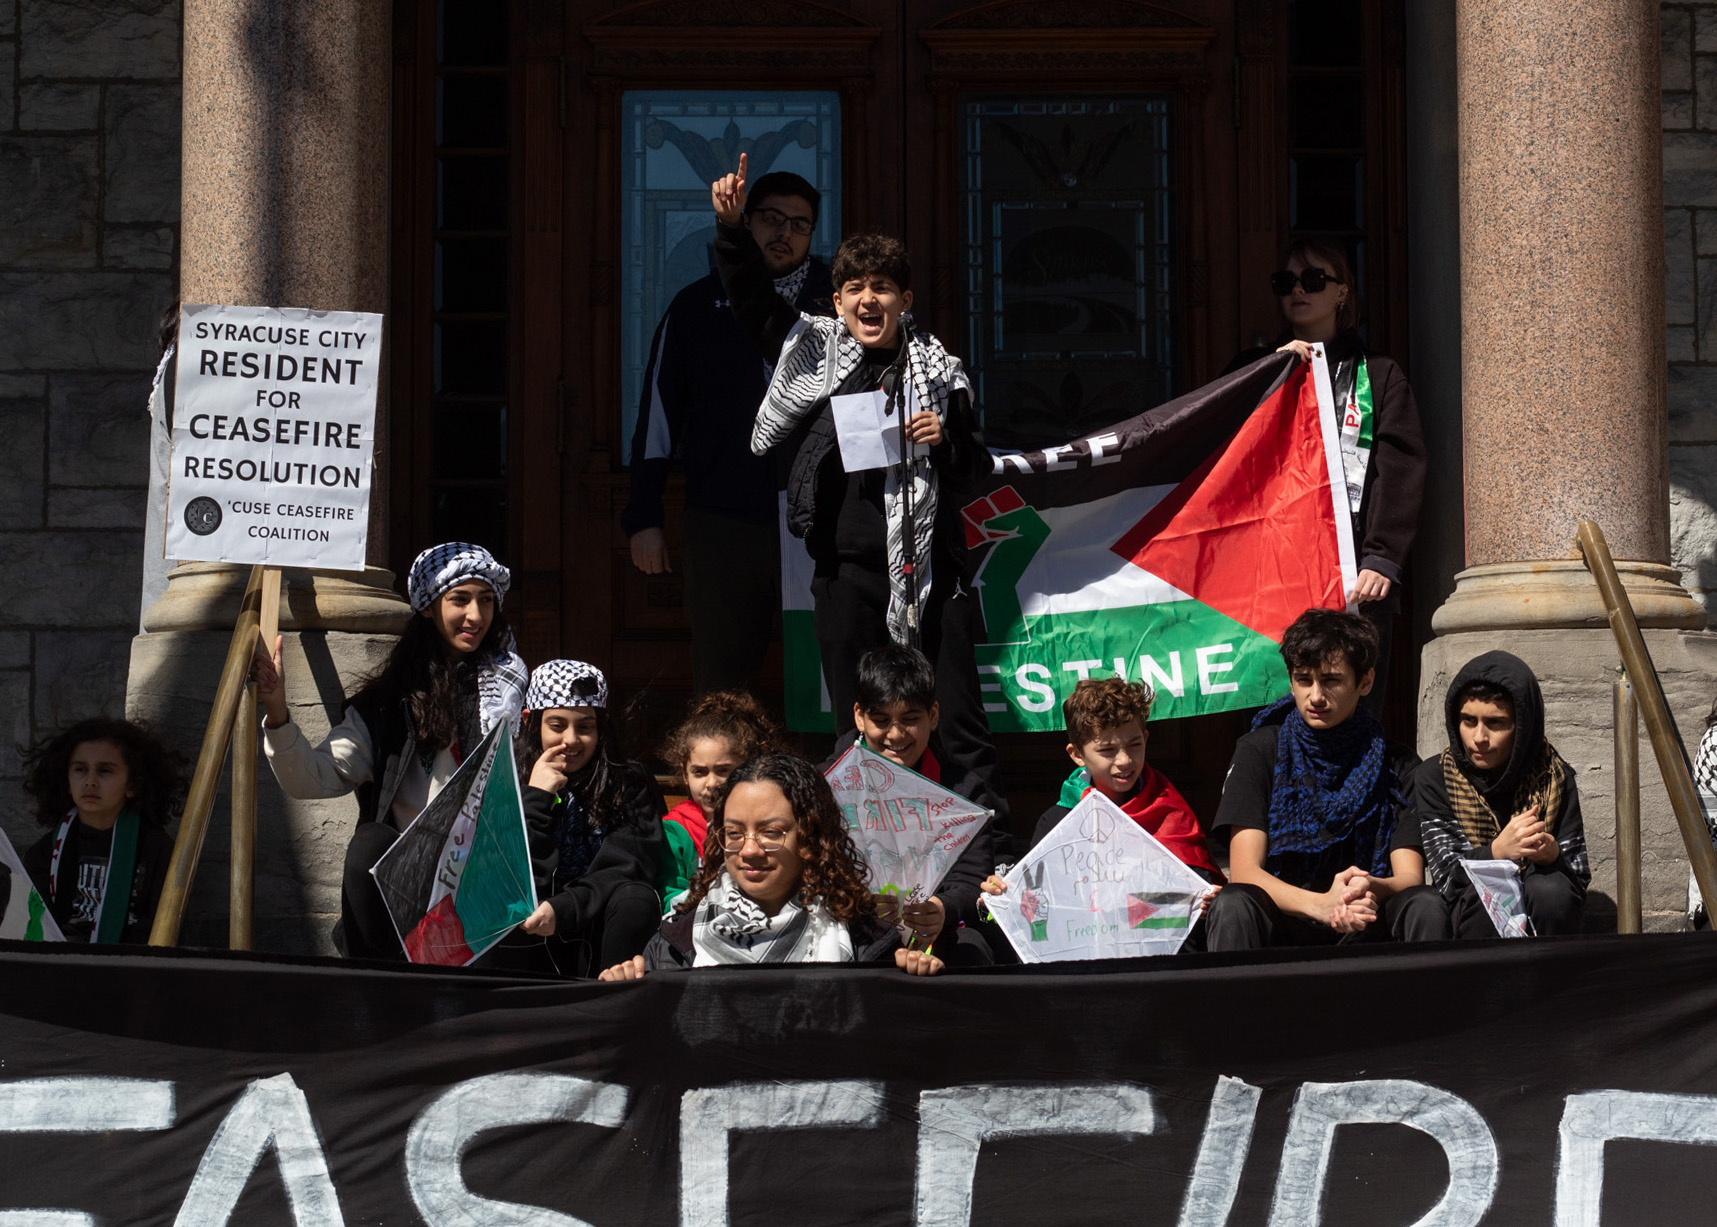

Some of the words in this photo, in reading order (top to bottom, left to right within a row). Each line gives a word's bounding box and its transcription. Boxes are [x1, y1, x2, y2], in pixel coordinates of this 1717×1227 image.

[195, 322, 310, 346] SYRACUSE
[318, 330, 367, 349] CITY
[199, 349, 364, 385] RESIDENT
[256, 389, 301, 409] FOR
[189, 414, 361, 450] CEASEFIRE
[991, 432, 1122, 474] REE
[184, 456, 361, 488] RESOLUTION
[277, 503, 354, 520] CEASEFIRE
[248, 525, 330, 542] COALITION
[976, 643, 1239, 713] ESTINE
[438, 832, 465, 890] Free
[1061, 844, 1126, 876] Peace
[1066, 919, 1119, 942] Freedom
